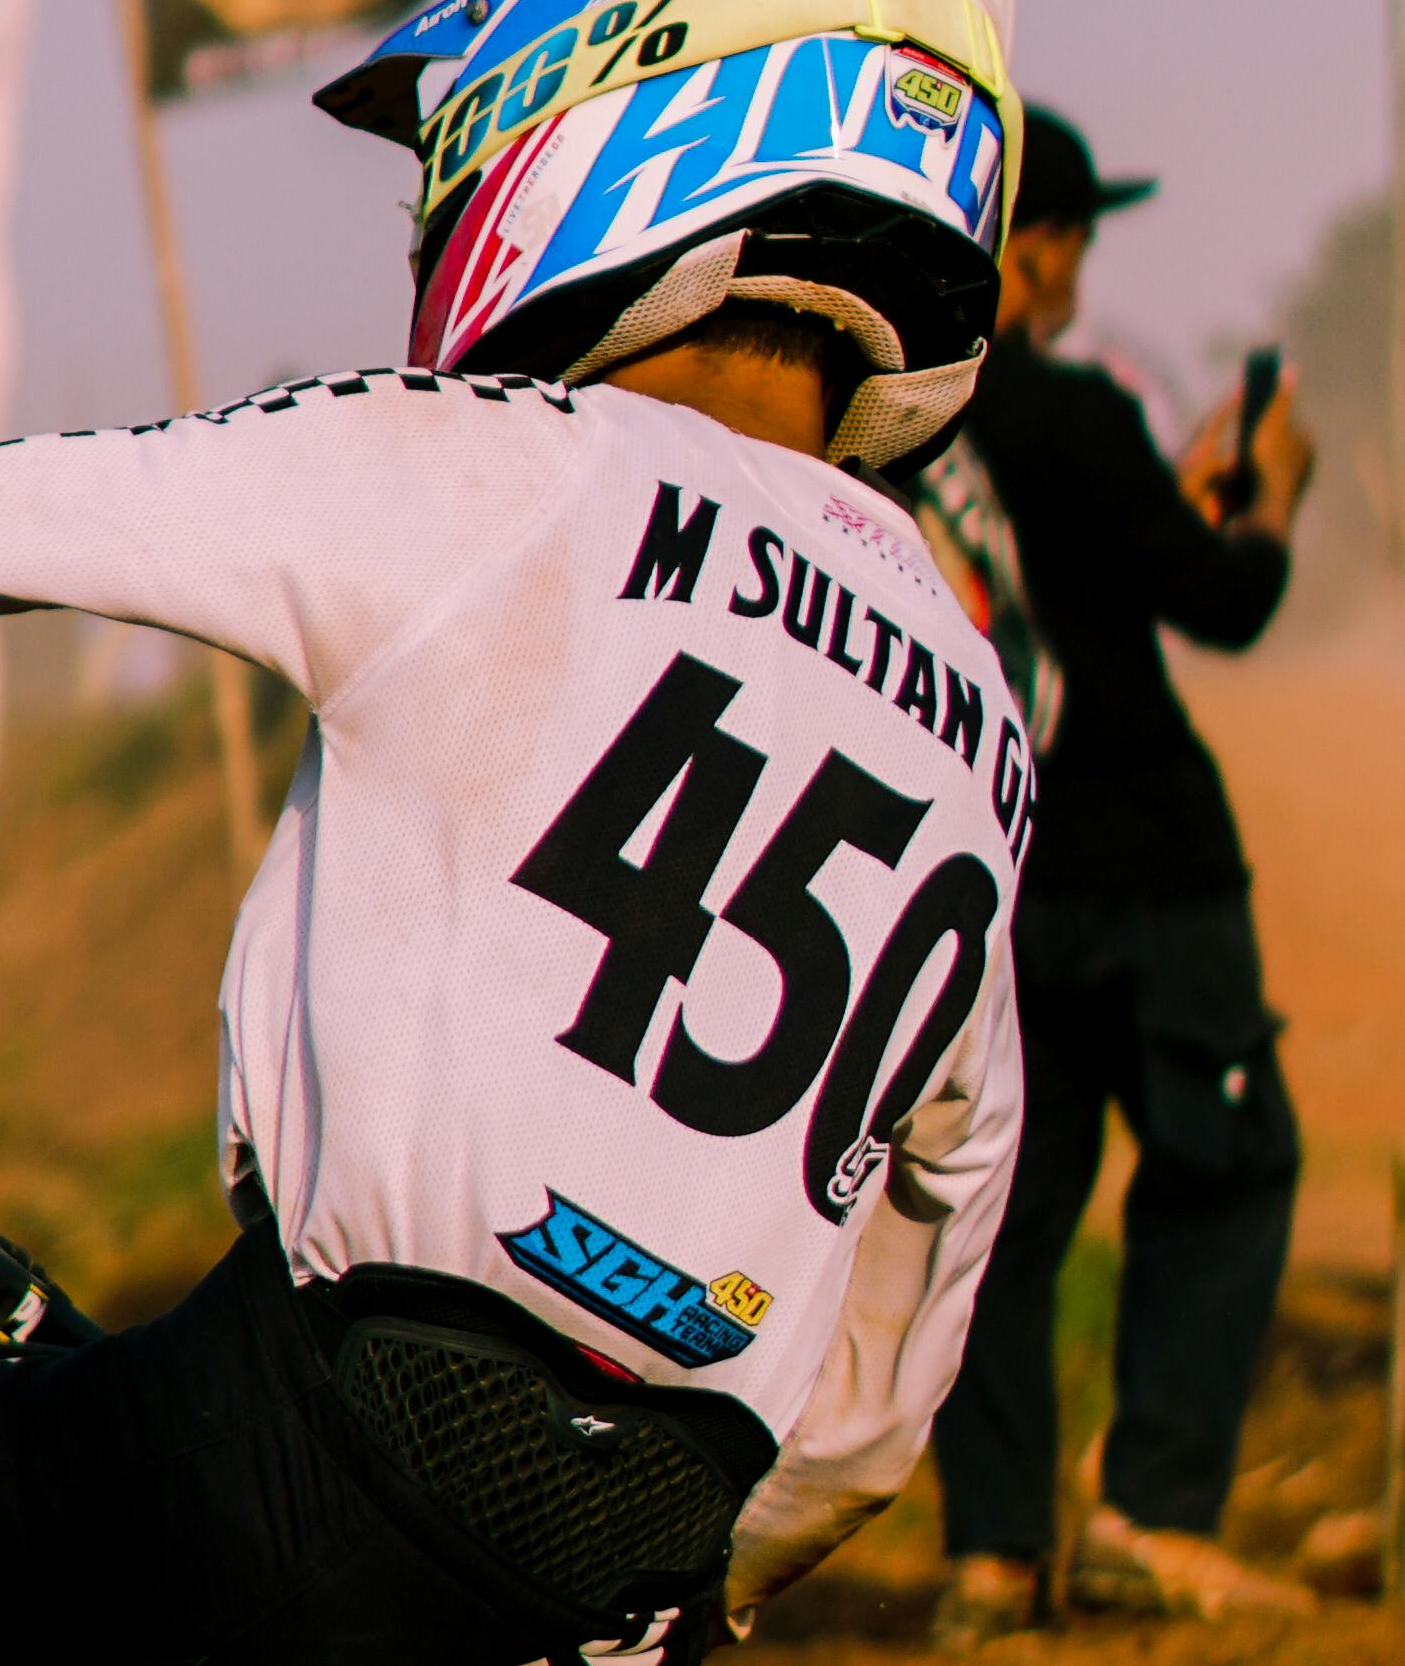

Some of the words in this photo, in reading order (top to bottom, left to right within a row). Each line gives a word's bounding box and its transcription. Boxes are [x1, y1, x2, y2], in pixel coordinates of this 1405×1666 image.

[896, 69, 962, 117] 450
[617, 480, 721, 604] M
[728, 526, 984, 773] SULTAN
[508, 649, 1000, 1226] 450
[509, 1196, 706, 1333] SGH
[709, 1270, 774, 1326] 450
[679, 1306, 748, 1351] RACING
